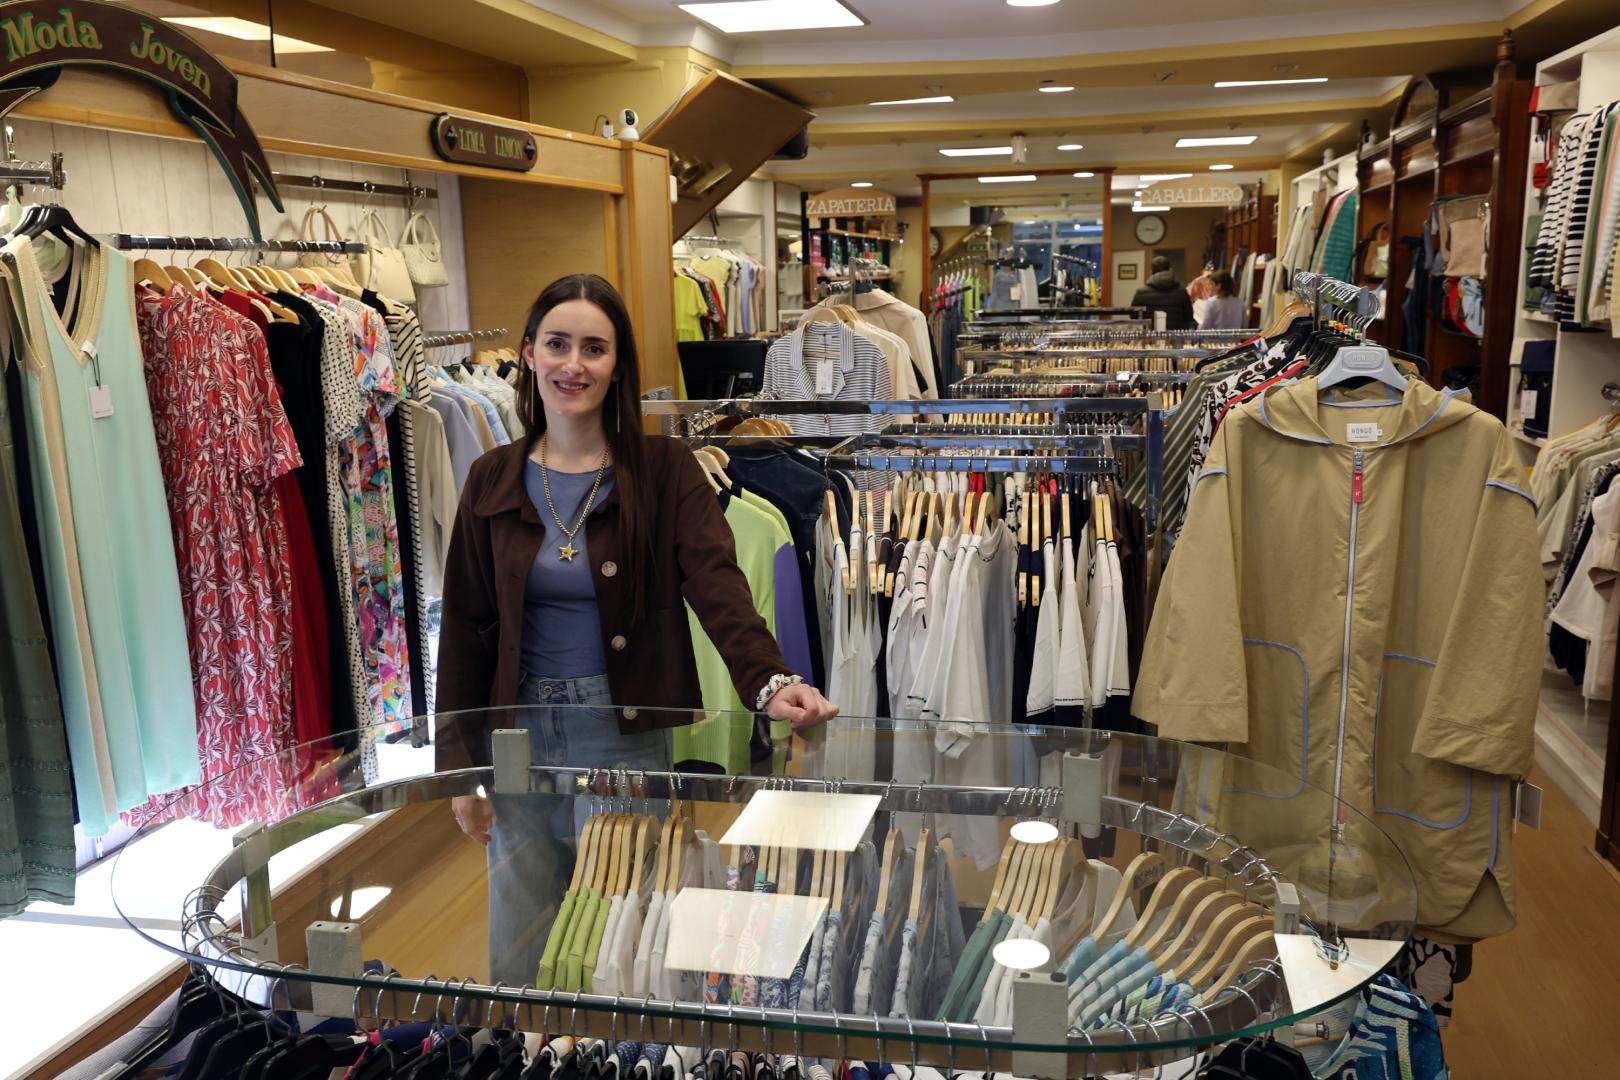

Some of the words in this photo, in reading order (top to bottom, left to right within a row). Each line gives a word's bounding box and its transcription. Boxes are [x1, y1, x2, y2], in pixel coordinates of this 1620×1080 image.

[2, 9, 103, 62] Moda
[130, 22, 212, 99] Joven
[459, 128, 486, 154] LIMA
[806, 197, 896, 214] ZAPATERIA
[1140, 185, 1244, 204] CABALLERO
